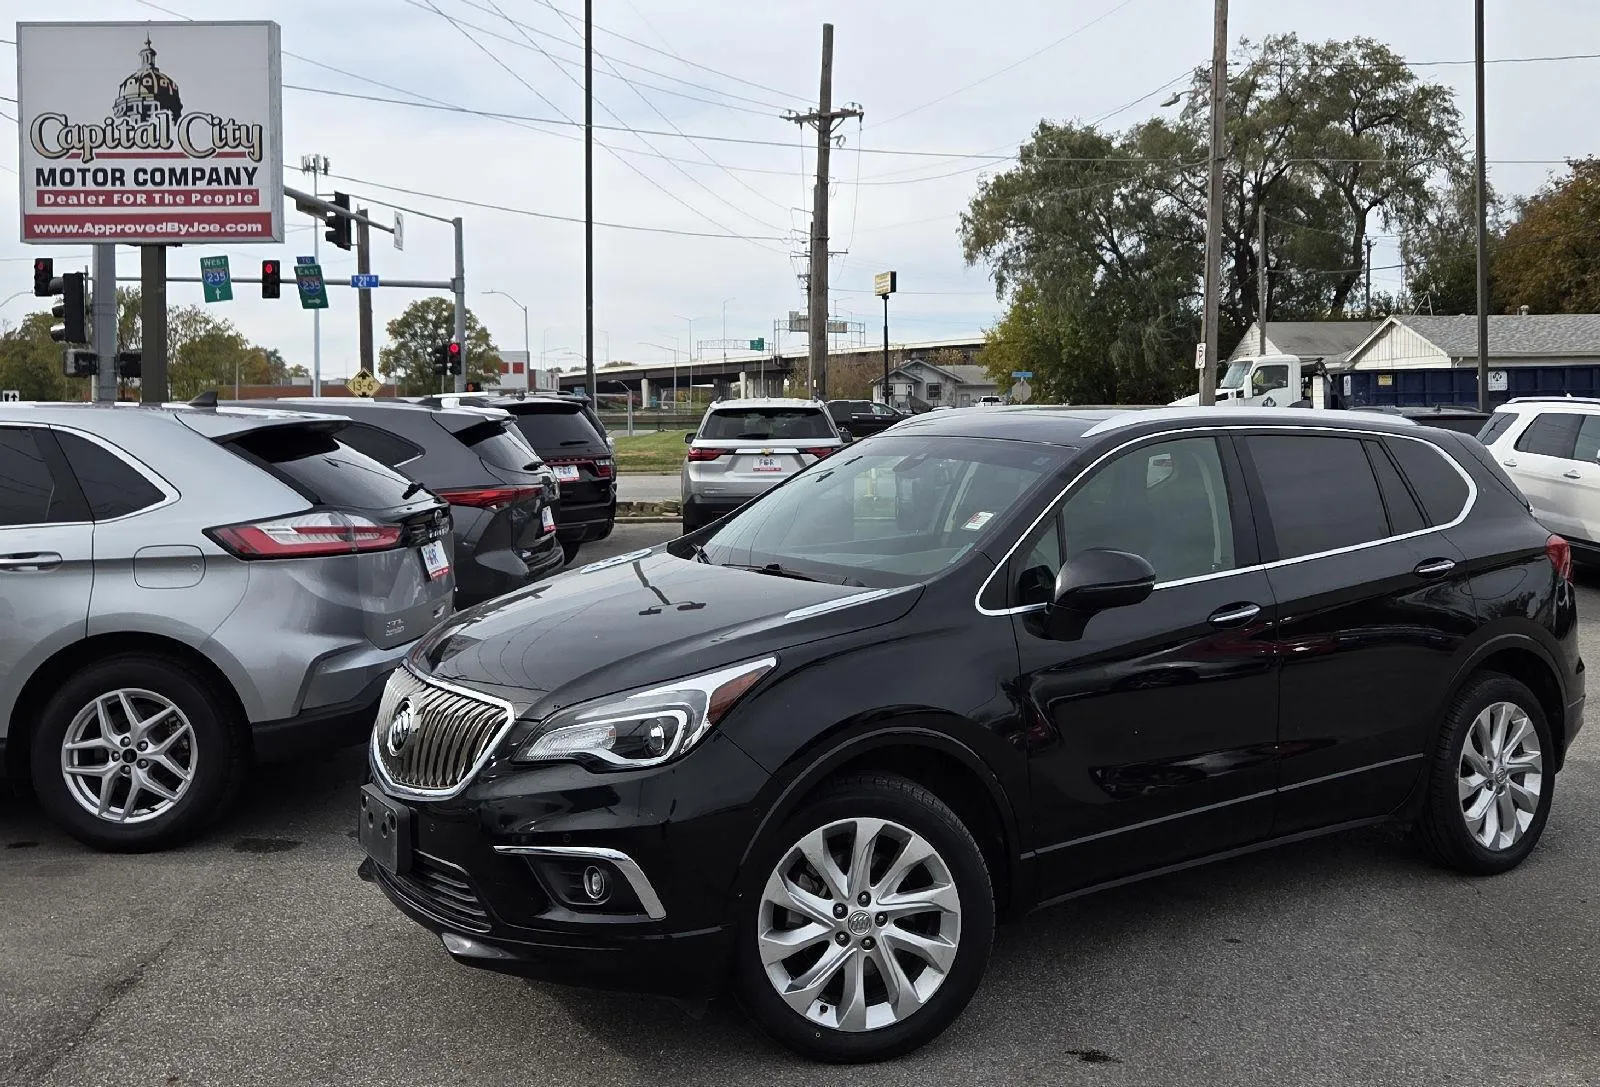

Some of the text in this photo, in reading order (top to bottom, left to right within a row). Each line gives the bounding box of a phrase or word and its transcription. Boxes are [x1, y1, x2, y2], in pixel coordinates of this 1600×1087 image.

[30, 112, 262, 163] Capital City
[36, 166, 259, 187] MOTOR COMPANY
[44, 193, 254, 207] Dealer FOR The People
[33, 222, 262, 235] www.ApprovedByJoe.com
[203, 258, 226, 267] WEST
[297, 266, 319, 276] EAST
[208, 273, 226, 283] 235
[303, 280, 321, 290] 235
